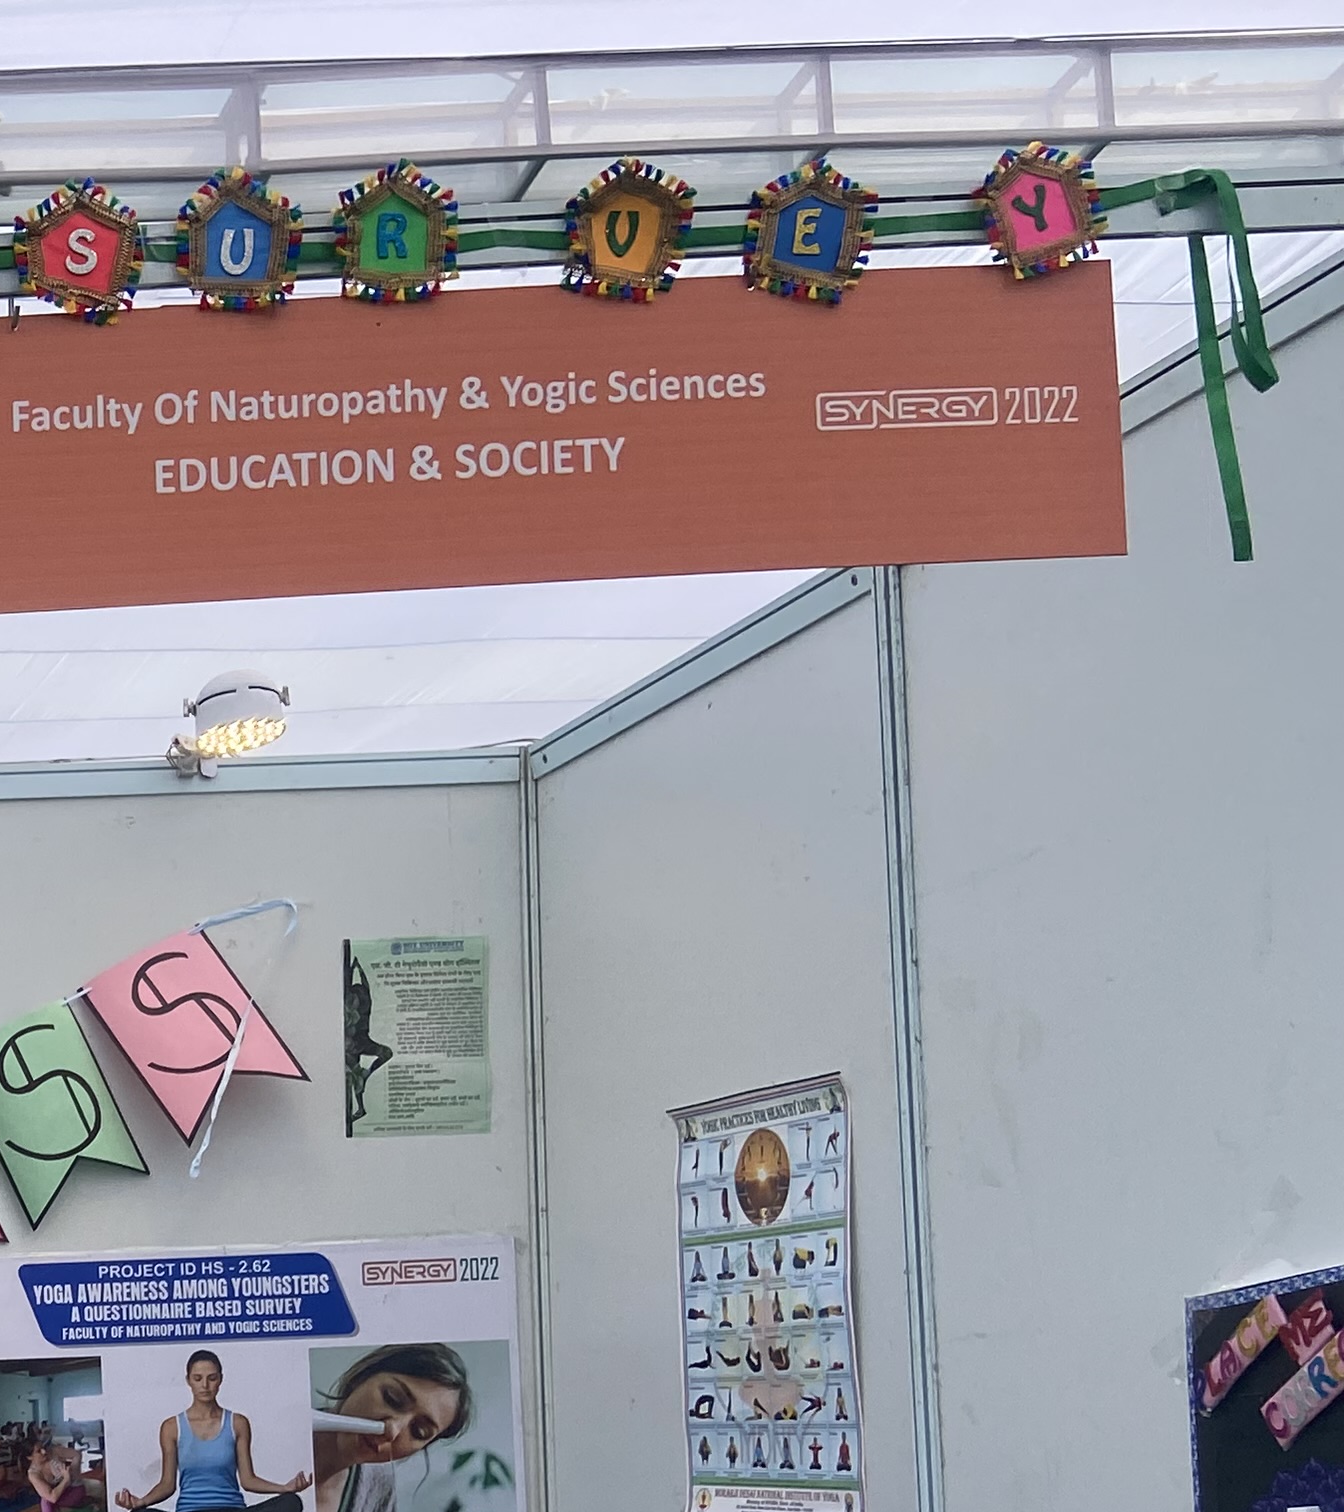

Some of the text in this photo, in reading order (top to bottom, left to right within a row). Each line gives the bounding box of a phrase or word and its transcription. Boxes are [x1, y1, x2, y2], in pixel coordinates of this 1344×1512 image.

[12, 368, 766, 434] Faculty Of Naturopathy & Yogic Sciences
[820, 387, 1078, 428] SYNERGY 2022
[155, 437, 625, 494] EDUCATION & SOCIETY
[98, 1263, 175, 1279] PROJECT
[180, 1261, 196, 1276] ID
[201, 1261, 225, 1274] HS
[239, 1260, 271, 1274] 2.62
[364, 1257, 499, 1284] SYNERGY 2022
[33, 1274, 330, 1305] YOGA AWARENESS AMONG YOUNGSTERS
[71, 1298, 302, 1323] A QUESTIONNAIRE BASED SURVEY
[62, 1318, 313, 1341] FACULTY OF NATUROPATHY AND YOGIC SCIENCES
